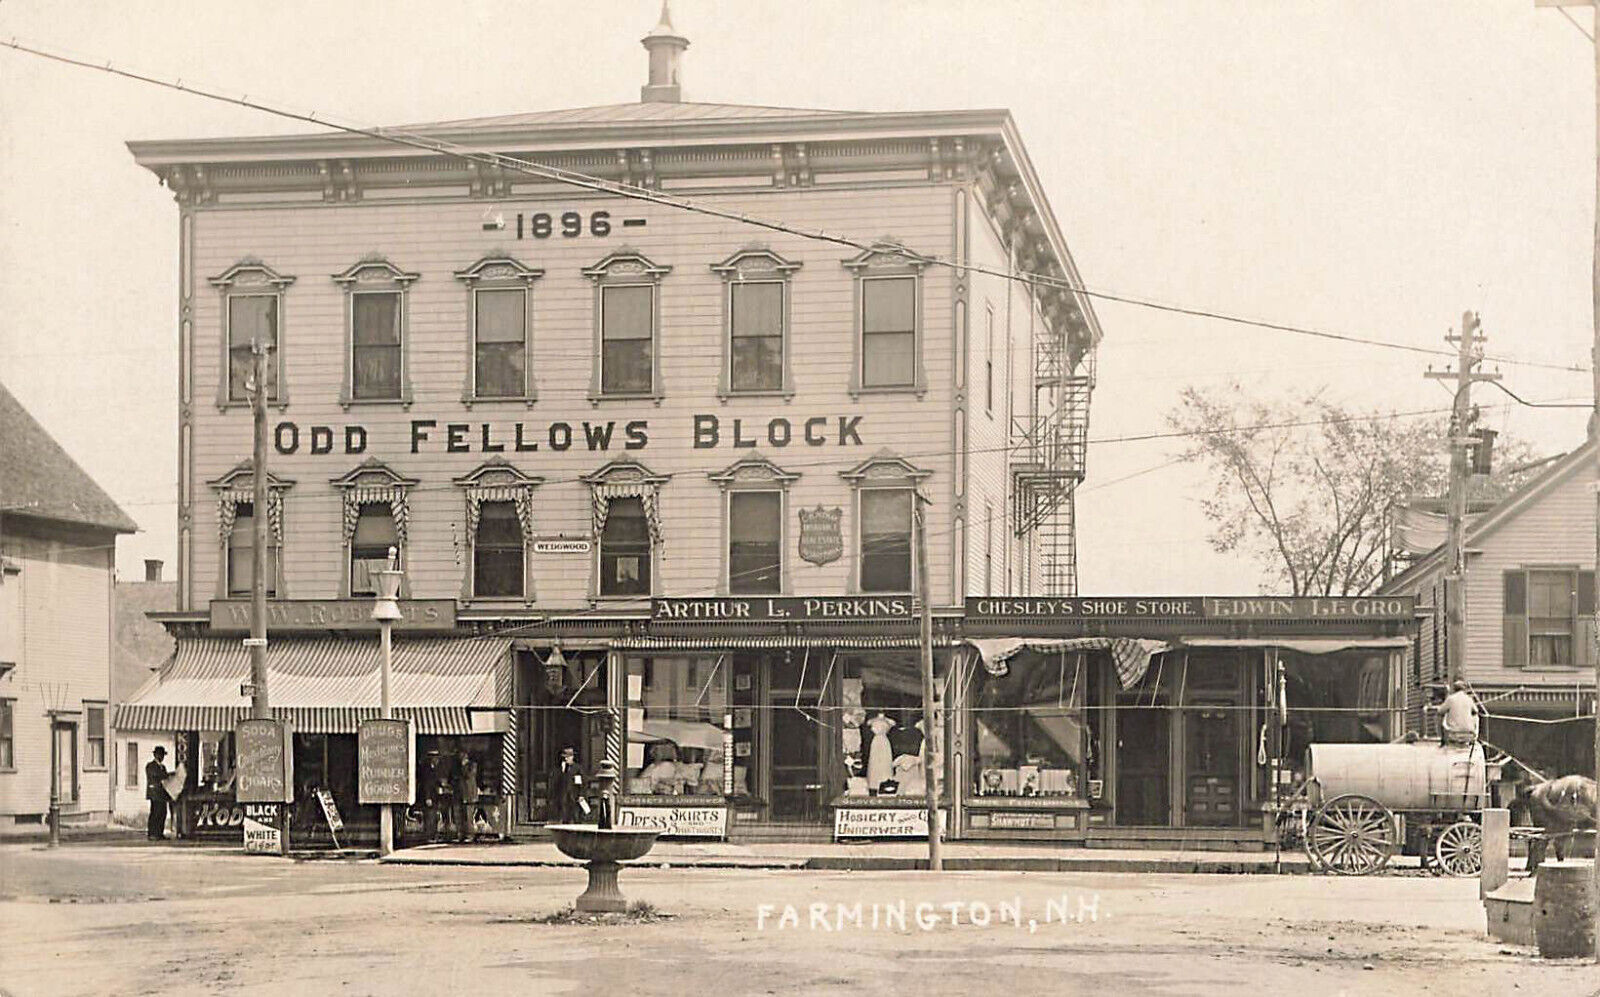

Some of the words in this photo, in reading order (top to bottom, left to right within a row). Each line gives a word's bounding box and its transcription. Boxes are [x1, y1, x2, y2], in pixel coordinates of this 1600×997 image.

[517, 211, 611, 240] 1896
[274, 421, 367, 455] ODD
[411, 420, 648, 453] FELLOWS
[693, 414, 863, 449] BLOCK
[308, 604, 440, 625] ROBTS
[655, 601, 750, 618] ARTHUR
[768, 600, 791, 618] L.
[804, 600, 909, 616] PERKINS.
[977, 600, 1073, 615] CHESLEY'S
[1081, 600, 1128, 615] SHOE
[1135, 600, 1196, 615] STORE.
[1213, 599, 1294, 617] EDWIN
[242, 725, 276, 738] SODA
[246, 804, 278, 817] BLACK
[669, 808, 719, 822] SKIRTS
[839, 810, 897, 822] HOSIERY
[246, 830, 278, 840] WHITE
[838, 823, 913, 835] UNDERWEAR
